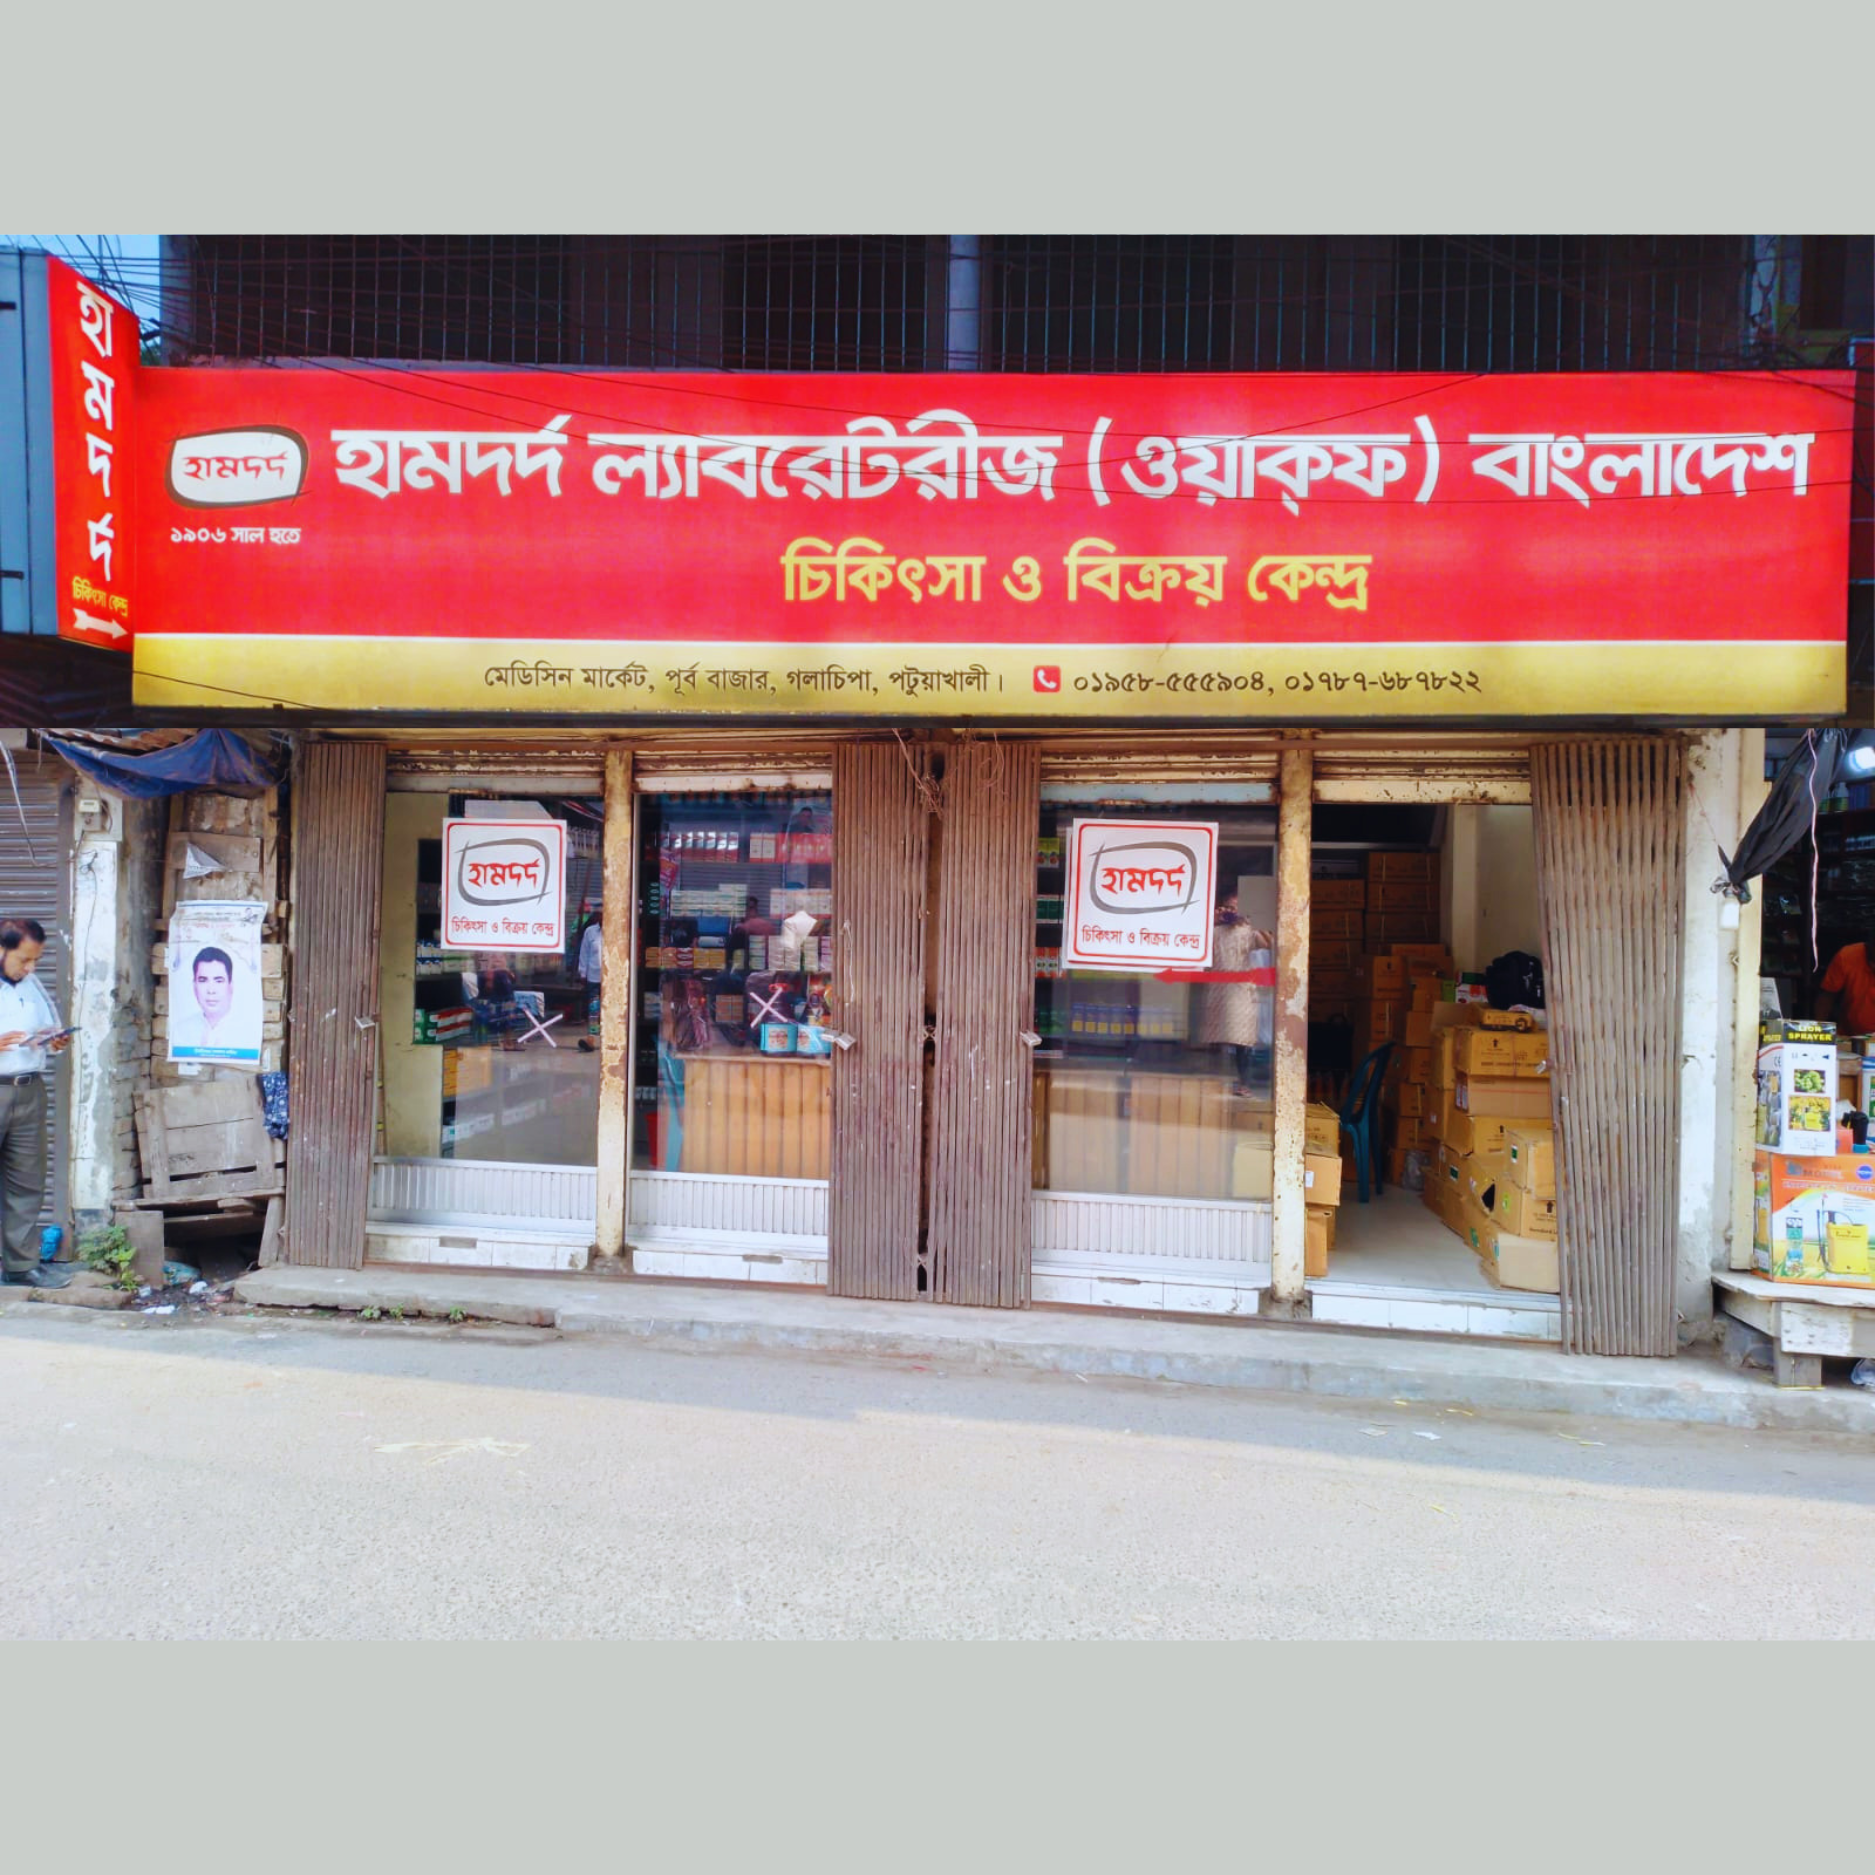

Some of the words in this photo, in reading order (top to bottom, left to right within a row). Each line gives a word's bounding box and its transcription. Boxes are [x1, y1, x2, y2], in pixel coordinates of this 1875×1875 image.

[182, 450, 288, 481] হামদর্দ
[331, 415, 572, 498] হামদর্দ
[588, 409, 1063, 503] ল্যাবরেটরীজ
[1468, 432, 1816, 508] বাংলাদেশ
[170, 527, 227, 544] ১৯০৬
[230, 526, 266, 544] সাল
[268, 527, 302, 545] হতে
[780, 536, 987, 603] চিকিৎসা
[1003, 556, 1042, 602] ও
[1063, 537, 1228, 608] বিক্রয়
[1247, 554, 1373, 612] কেন্দ্র
[484, 659, 574, 688] মেডিসিন
[581, 660, 655, 693] মার্কেট,
[665, 661, 700, 696] পূর্ব
[706, 667, 777, 696] বাজার,
[786, 663, 878, 696] গলাচিপা,
[1073, 670, 1275, 695] ০১৯৫৮-৫৫৫৯০৪,
[1285, 671, 1482, 693] ০১৭৮৭-৬৮৭৮২২
[468, 858, 541, 889] হামদর্দ
[1101, 864, 1186, 897] হামদর্দ
[451, 915, 488, 934] চিকিৎসা
[491, 922, 499, 934] ও
[501, 917, 528, 934] বিক্রয়
[532, 922, 554, 937] কেন্দ্র
[1082, 925, 1123, 944] চিকিৎসা
[1127, 931, 1136, 944] ও
[1140, 928, 1171, 947] বিক্রয়
[1174, 933, 1201, 949] কেন্দ্র
[1788, 1031, 1833, 1041] SPRAYER
